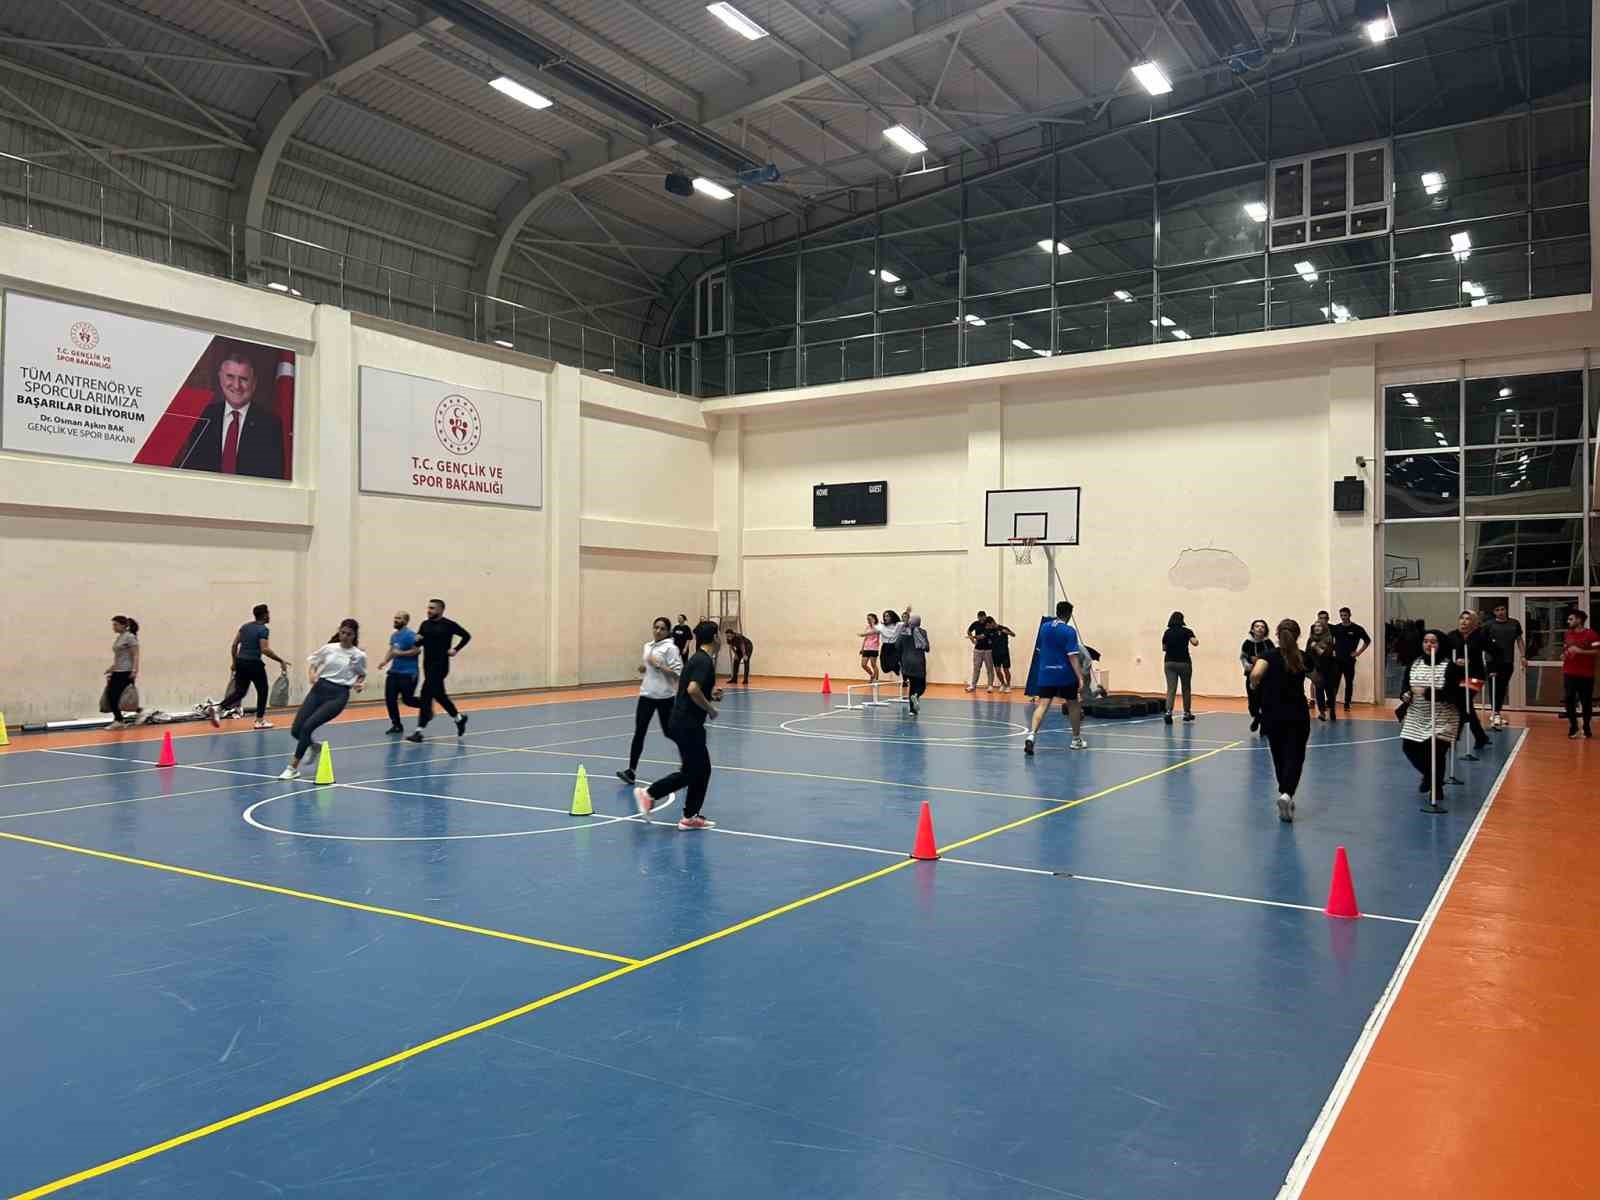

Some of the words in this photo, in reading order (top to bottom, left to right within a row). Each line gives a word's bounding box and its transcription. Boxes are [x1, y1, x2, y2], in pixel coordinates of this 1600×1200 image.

[20, 366, 51, 382] TÜM
[55, 373, 125, 393] ANTRENÖR
[127, 385, 143, 397] VE
[24, 381, 139, 408] SPORCULARIMIZA
[16, 394, 82, 412] BAŞARILAR
[84, 404, 145, 422] DİLİYORUM
[27, 422, 66, 434] GENÇLİK
[67, 428, 79, 437] VE
[79, 430, 103, 440] SPOR
[104, 432, 136, 444] BAKANI
[40, 414, 53, 422] Dr.
[53, 416, 83, 427] Osman
[107, 423, 124, 432] BAK
[411, 457, 433, 471] T.C.
[437, 460, 486, 477] GENÇLİK
[489, 467, 503, 479] VE
[412, 473, 443, 488] SPOR
[446, 478, 503, 494] BAKANLIĞI
